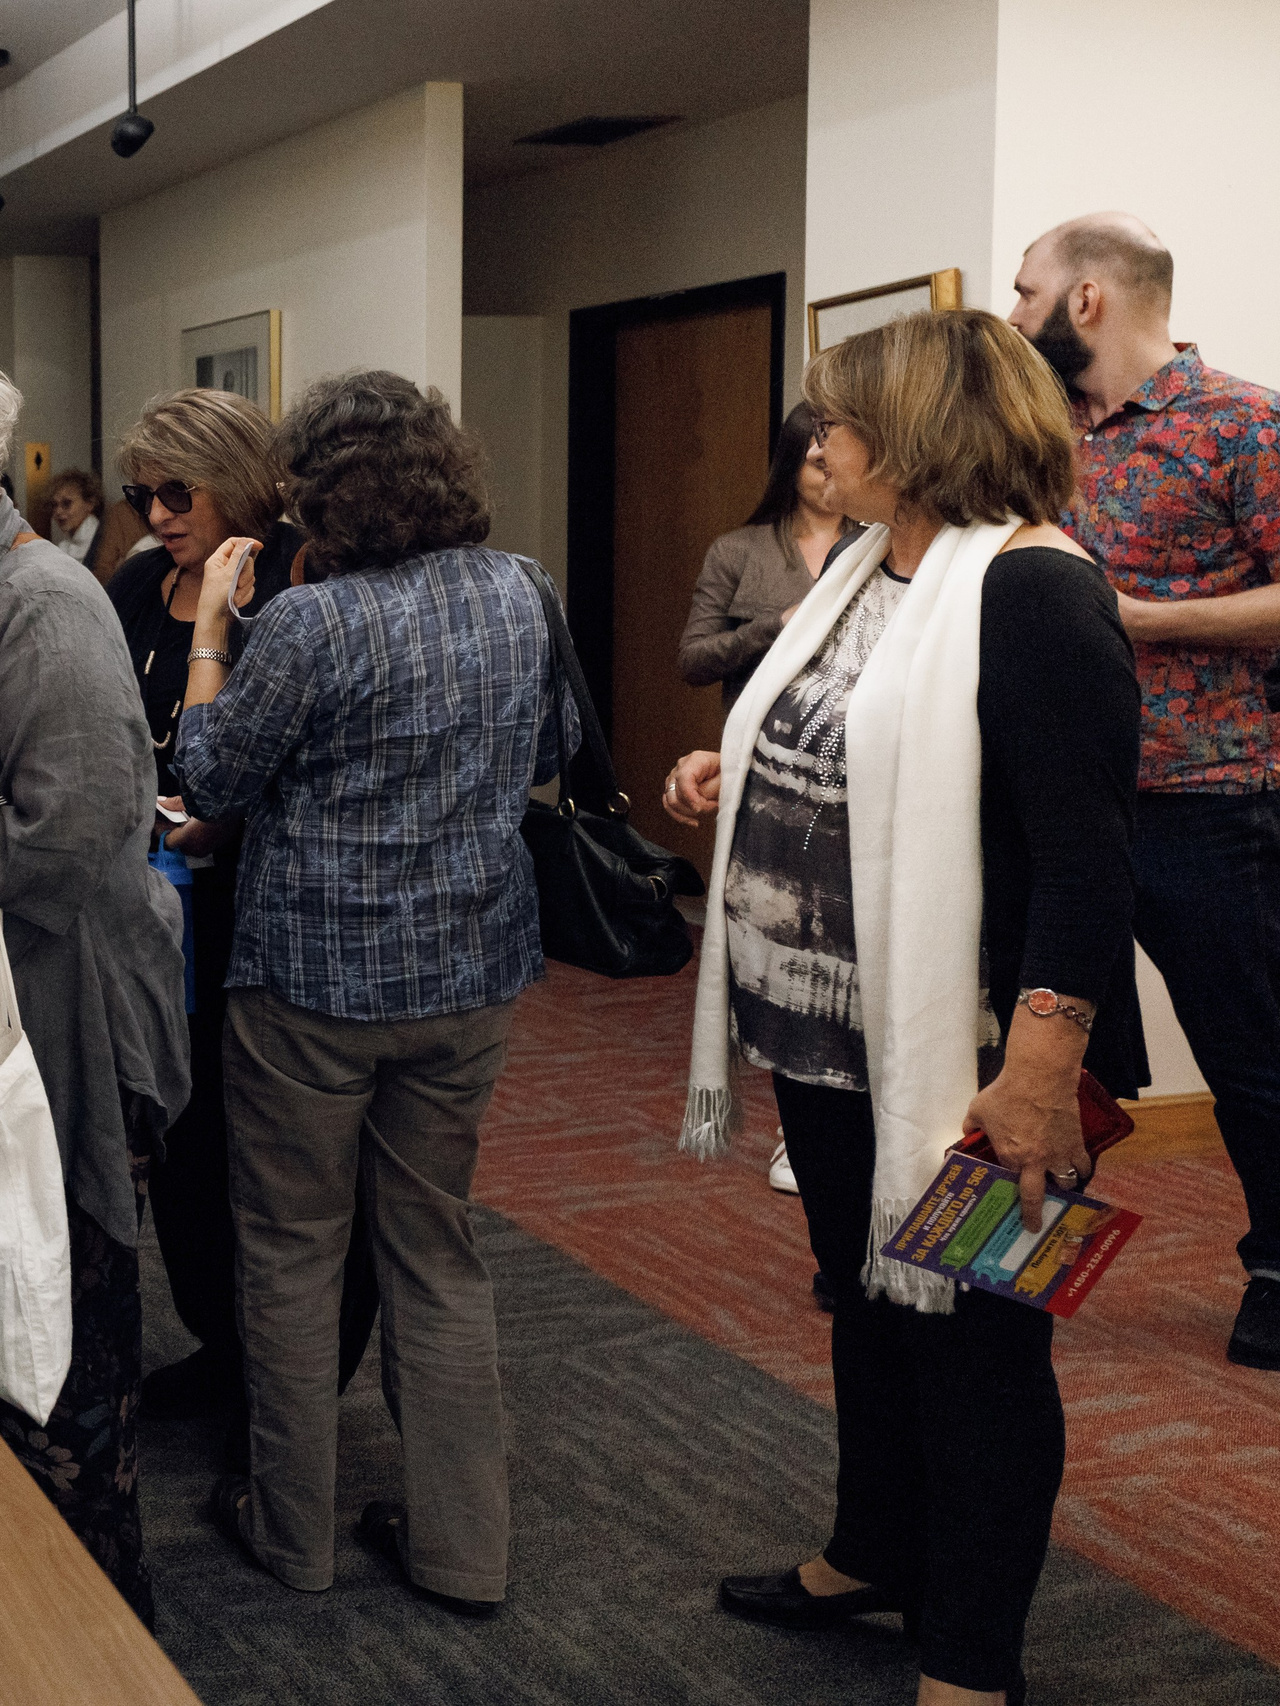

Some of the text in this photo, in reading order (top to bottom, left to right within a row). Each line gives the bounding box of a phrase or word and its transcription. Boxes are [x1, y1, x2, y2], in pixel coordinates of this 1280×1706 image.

[895, 1164, 963, 1251] ПРИГЛАШАЙТЕ ДРУЗЕЙ
[911, 1248, 929, 1262] ЗА
[921, 1200, 963, 1248] КАЖДОГО
[967, 1165, 989, 1186] 50$
